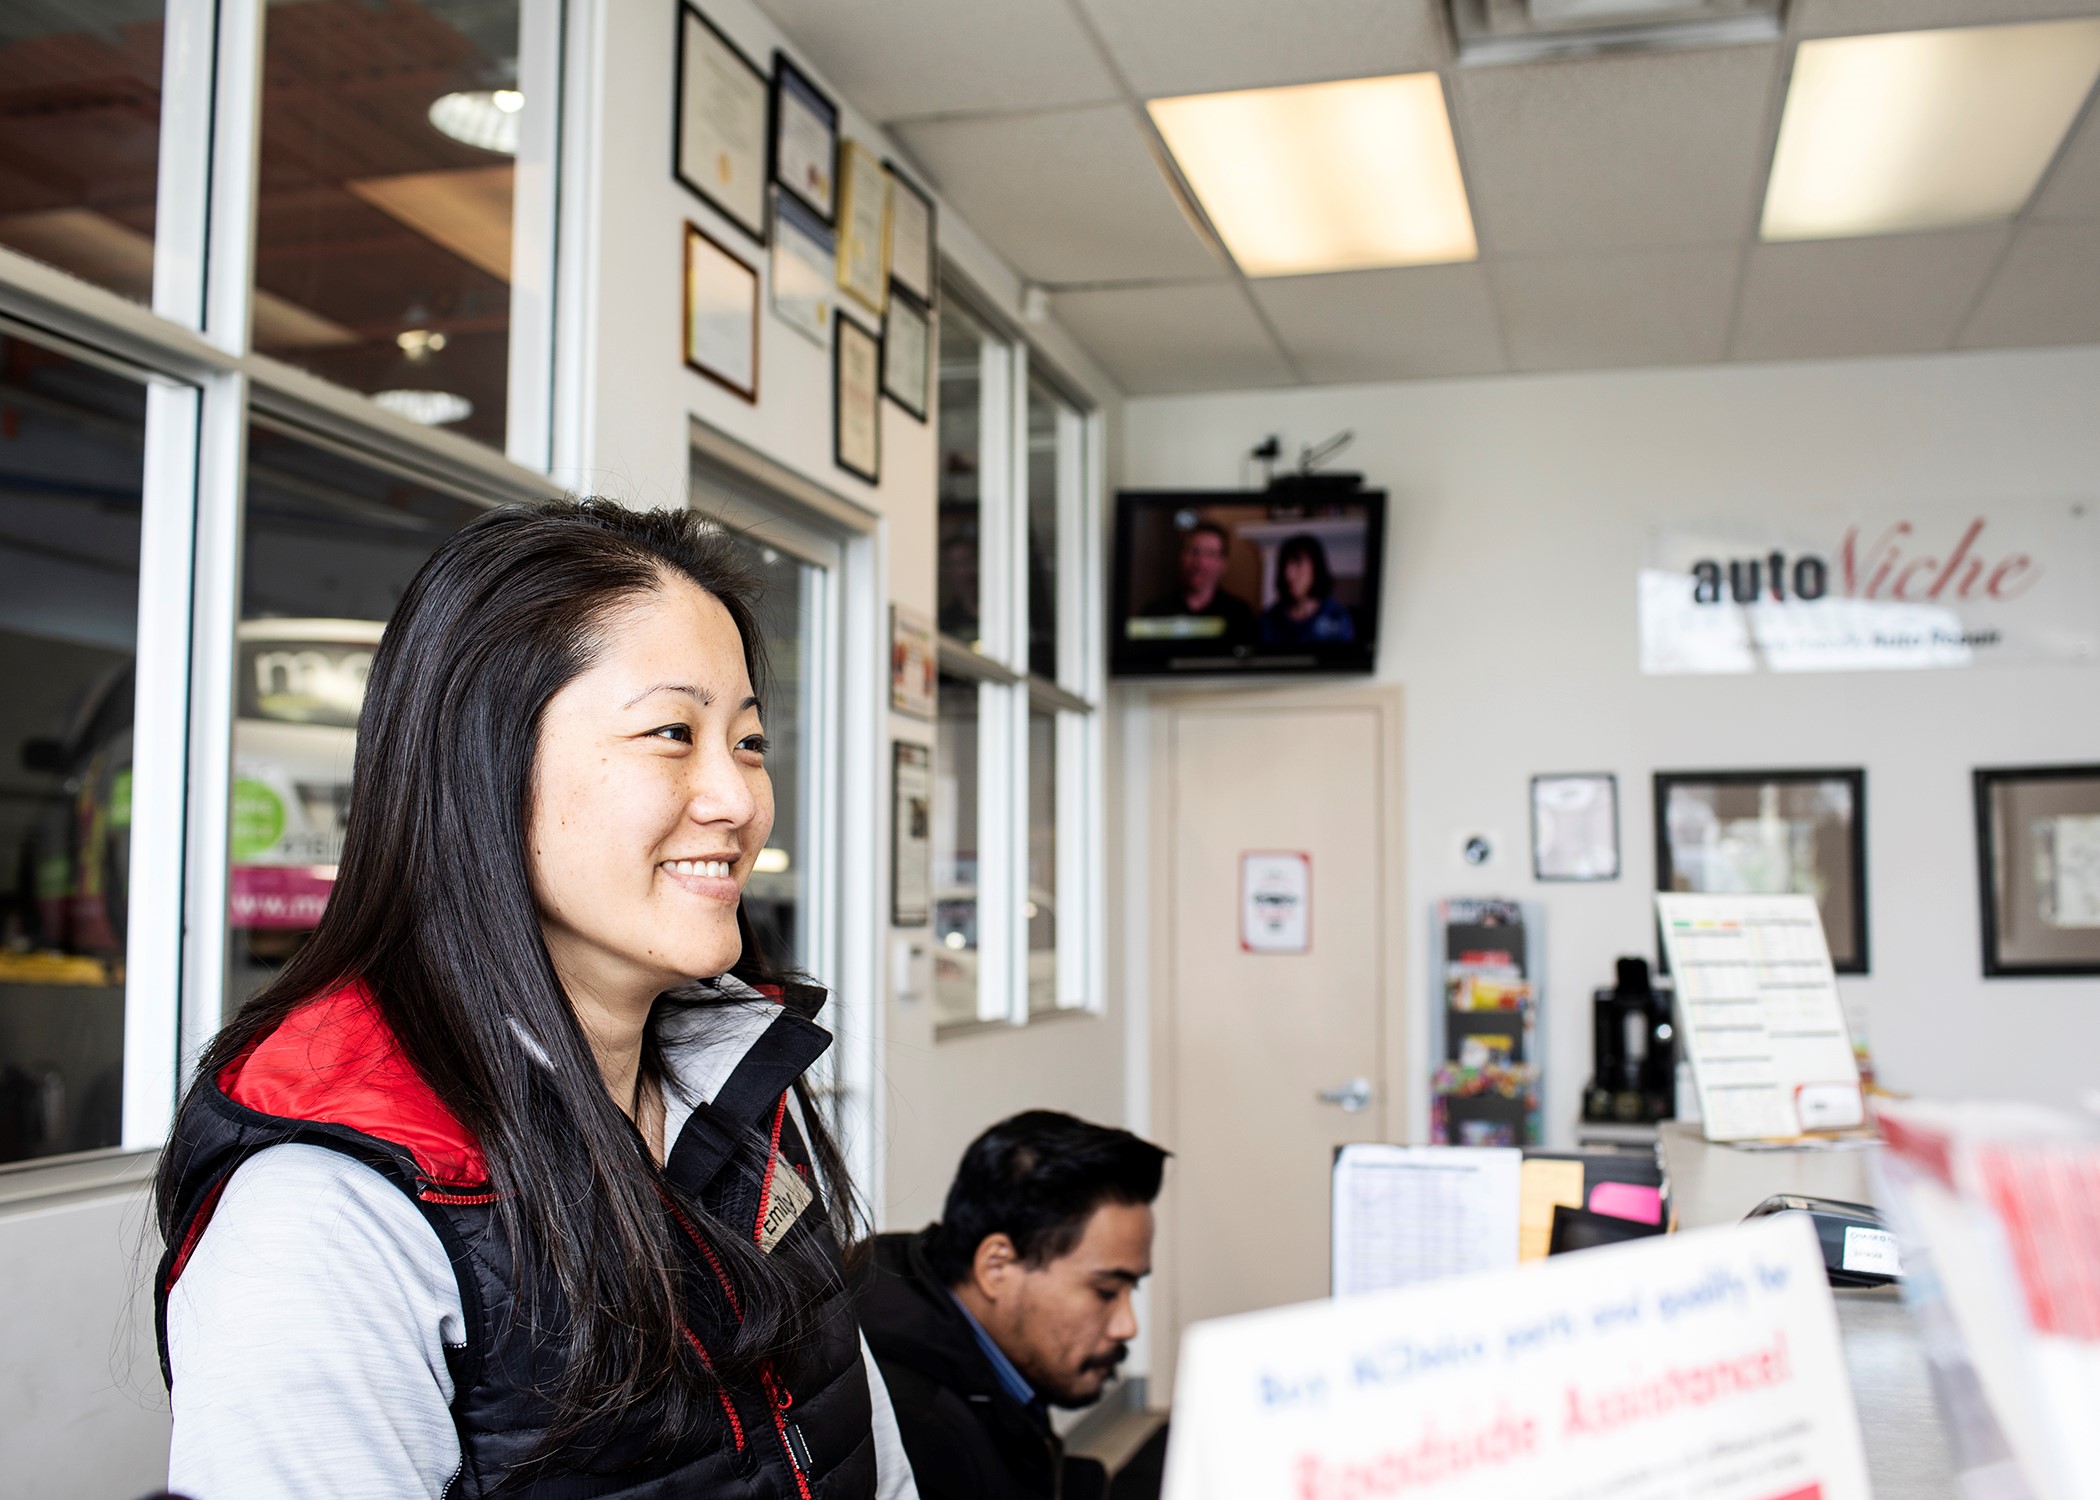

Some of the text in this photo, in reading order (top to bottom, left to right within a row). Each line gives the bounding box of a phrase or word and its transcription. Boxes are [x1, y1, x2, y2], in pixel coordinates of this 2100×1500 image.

[764, 1192, 797, 1236] Emily
[1294, 1402, 1537, 1500] Roadside
[1562, 1332, 1793, 1438] Assistance!
